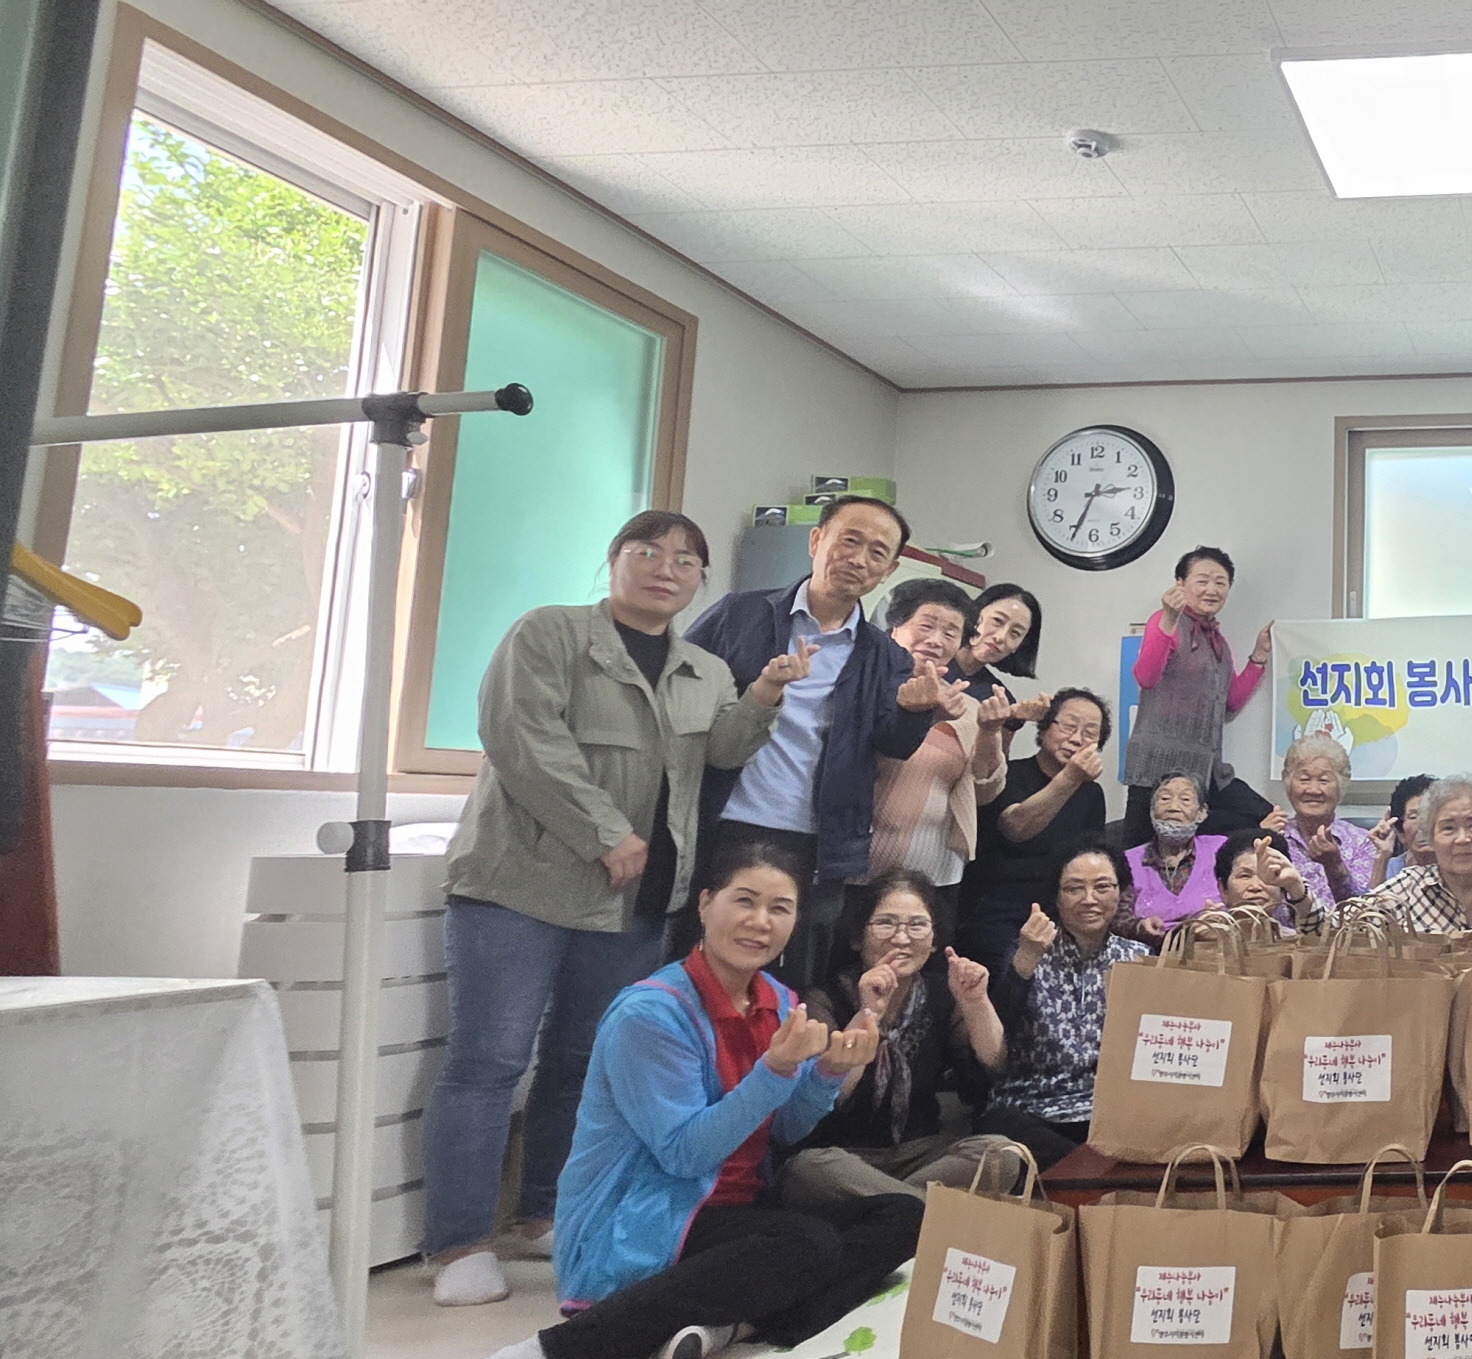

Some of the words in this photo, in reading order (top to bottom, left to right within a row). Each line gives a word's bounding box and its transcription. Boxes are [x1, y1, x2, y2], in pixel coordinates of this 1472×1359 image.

[1090, 445, 1105, 459] 12
[1116, 451, 1121, 463] 1
[1071, 453, 1081, 466] 11
[1054, 470, 1067, 483] 10
[1127, 465, 1138, 477] 2
[1047, 488, 1058, 502] 9
[1134, 486, 1144, 500] 3
[1052, 509, 1064, 523] 8
[1124, 506, 1136, 520] 4
[1088, 529, 1099, 542] 6
[1110, 523, 1121, 536] 5
[1300, 660, 1396, 707] 선지회
[1358, 1313, 1374, 1327] 선지
